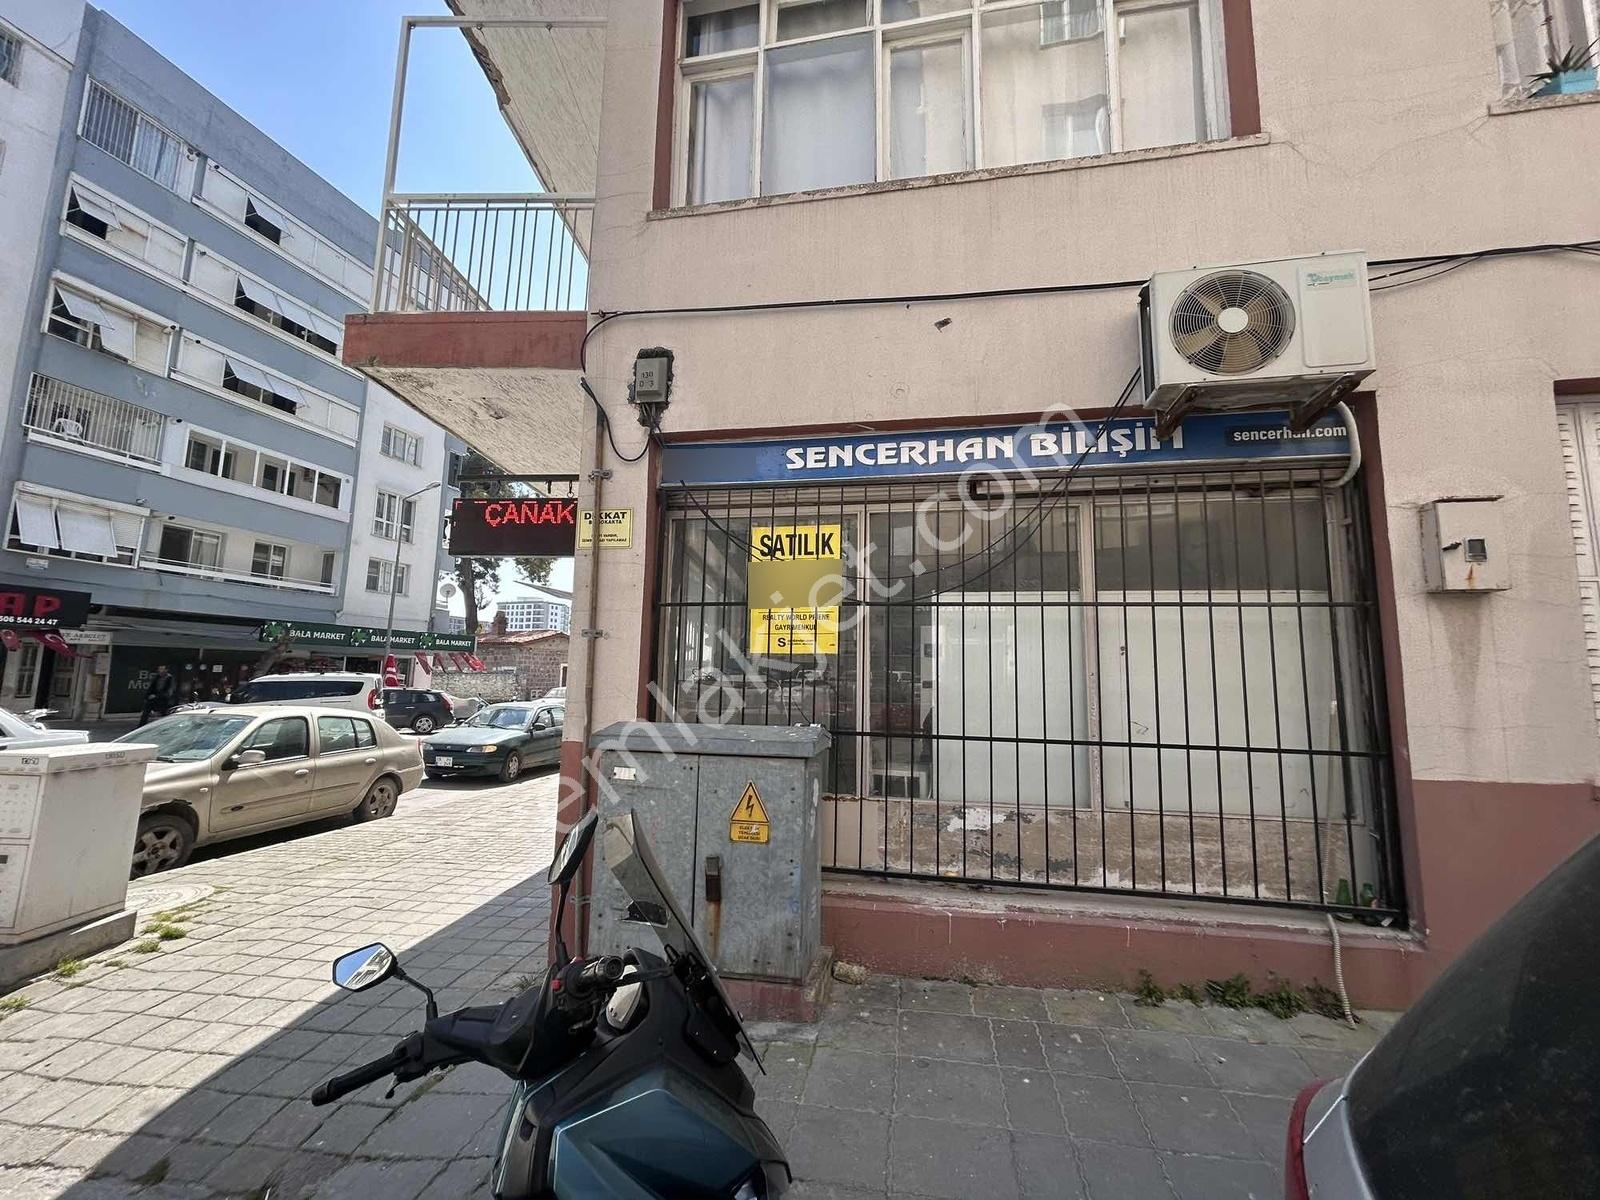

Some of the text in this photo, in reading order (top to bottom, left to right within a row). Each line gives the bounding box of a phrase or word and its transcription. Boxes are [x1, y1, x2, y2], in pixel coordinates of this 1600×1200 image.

[785, 435, 1014, 470] SENCERHAN
[485, 503, 575, 527] ÇANAK
[584, 511, 628, 520] DKKAT
[759, 532, 835, 557] SATILIK
[762, 612, 830, 621] REALTY WORLD PRENE
[289, 629, 346, 640] BALA MARKET
[389, 636, 415, 644] MARKET
[450, 639, 472, 647] MARKET
